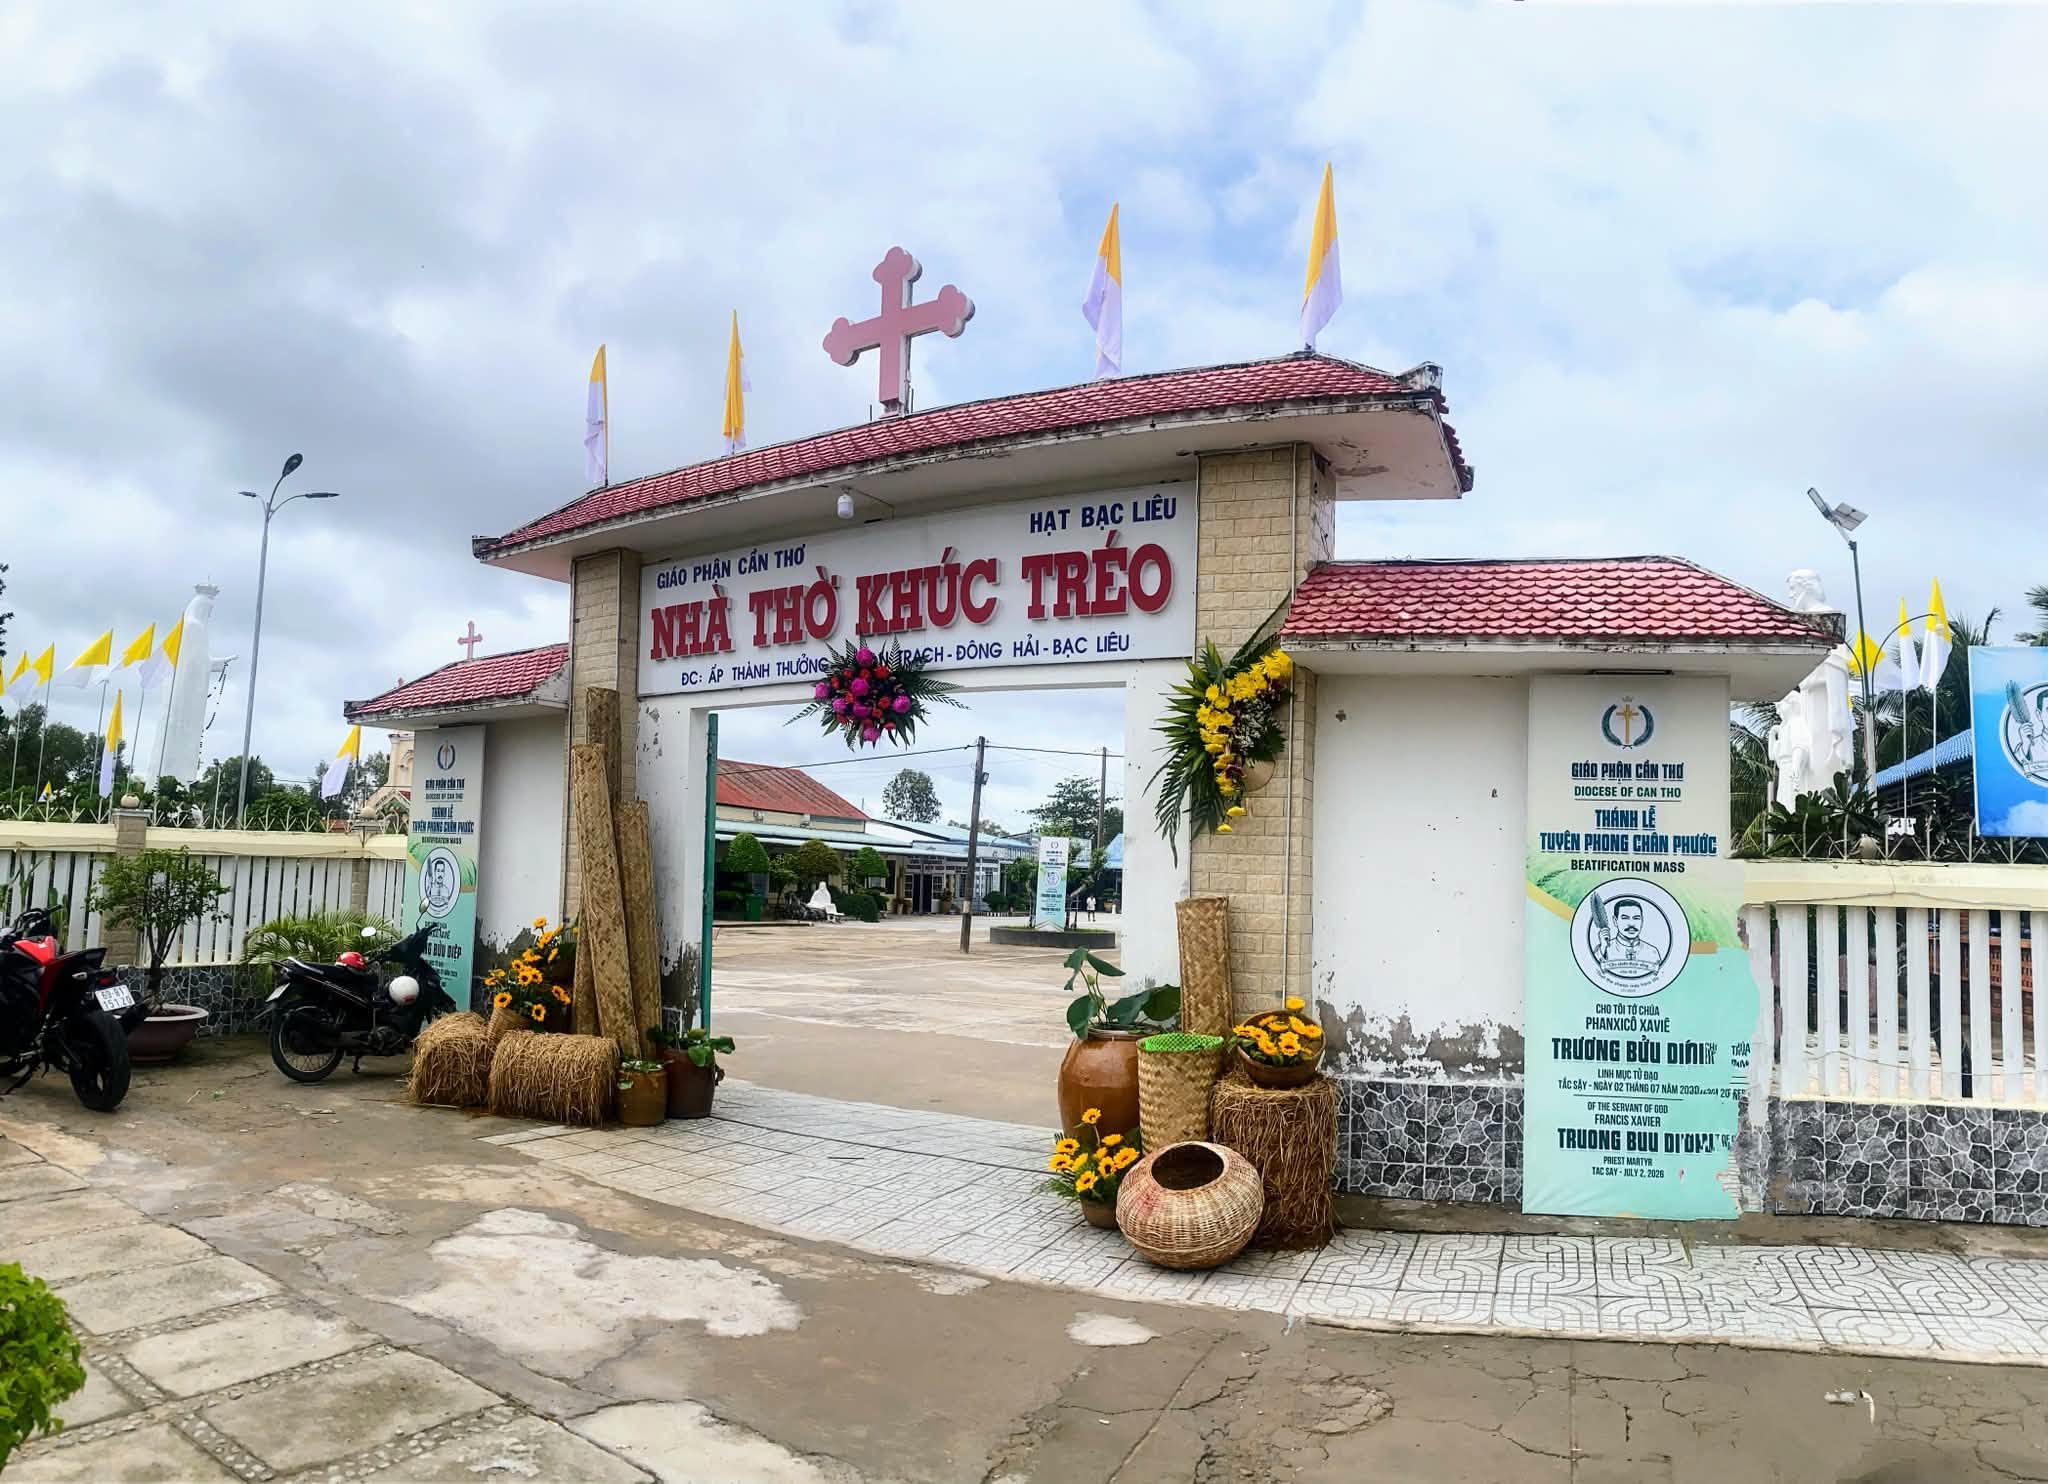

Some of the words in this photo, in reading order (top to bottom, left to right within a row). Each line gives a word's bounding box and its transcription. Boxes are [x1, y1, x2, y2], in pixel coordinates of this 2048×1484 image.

[1030, 508, 1070, 536] HẠT
[1081, 503, 1123, 531] BẠC
[1132, 494, 1177, 523] LIÊU
[657, 565, 687, 589] GIÁO
[693, 558, 731, 583] PHẬN
[774, 543, 806, 569] THƠ
[650, 583, 732, 660] NHÀ
[748, 565, 840, 647] THỜ
[855, 546, 998, 636] KHÚC
[1021, 529, 1173, 619] TRÉO
[681, 670, 703, 686] ĐC:
[708, 663, 724, 685] ẤP
[956, 640, 1002, 661] ĐÔNG
[1053, 636, 1088, 659] BẠC
[1096, 631, 1129, 652] LIÊU
[1571, 760, 1598, 778] GIÁO
[1601, 761, 1632, 783] PHẬN
[1662, 762, 1684, 779] THƠ
[1574, 786, 1617, 797] DIOCESE
[1620, 786, 1634, 797] OF
[1636, 787, 1657, 798] CAN
[1661, 787, 1681, 798] THO
[1594, 806, 1638, 828] THÁNH
[1642, 805, 1656, 828] LỄ
[1539, 829, 1580, 851] TUYÊN
[1584, 833, 1629, 852] PHONG
[1632, 831, 1669, 853] CHÂN
[1672, 832, 1718, 855] PHƯỚC
[1571, 859, 1650, 873] BEATIFICATION
[1653, 861, 1686, 874] MASS
[1614, 1002, 1626, 1015] TÔI
[1585, 1015, 1637, 1032] PHANXICÔ
[1640, 1017, 1670, 1033] XAVIÊ
[1551, 1036, 1620, 1062] TRƯƠNG
[1626, 1034, 1661, 1064] BỬU
[1597, 1068, 1615, 1080] LINH
[1616, 1069, 1632, 1082] MỤC
[1593, 1079, 1612, 1092] NGÀY
[1613, 1081, 1624, 1092] 02
[1650, 1083, 1660, 1094] 07
[1587, 1101, 1598, 1111] OF
[1597, 1101, 1611, 1111] THE
[1611, 1102, 1643, 1113] SERVANT
[1644, 1103, 1653, 1113] OF
[1654, 1104, 1669, 1114] GOD
[1594, 1114, 1629, 1126] FRANCIS
[1630, 1115, 1661, 1128] XAVIER
[1557, 1127, 1621, 1151] TRUONG
[1626, 1130, 1659, 1153] BUU
[1603, 1155, 1625, 1166] PRIEST
[1626, 1157, 1653, 1167] MARTYR
[1592, 1166, 1605, 1176] TAC
[1605, 1167, 1618, 1177] SAY
[1624, 1168, 1639, 1178] JULY
[1647, 1169, 1665, 1179] 2026
